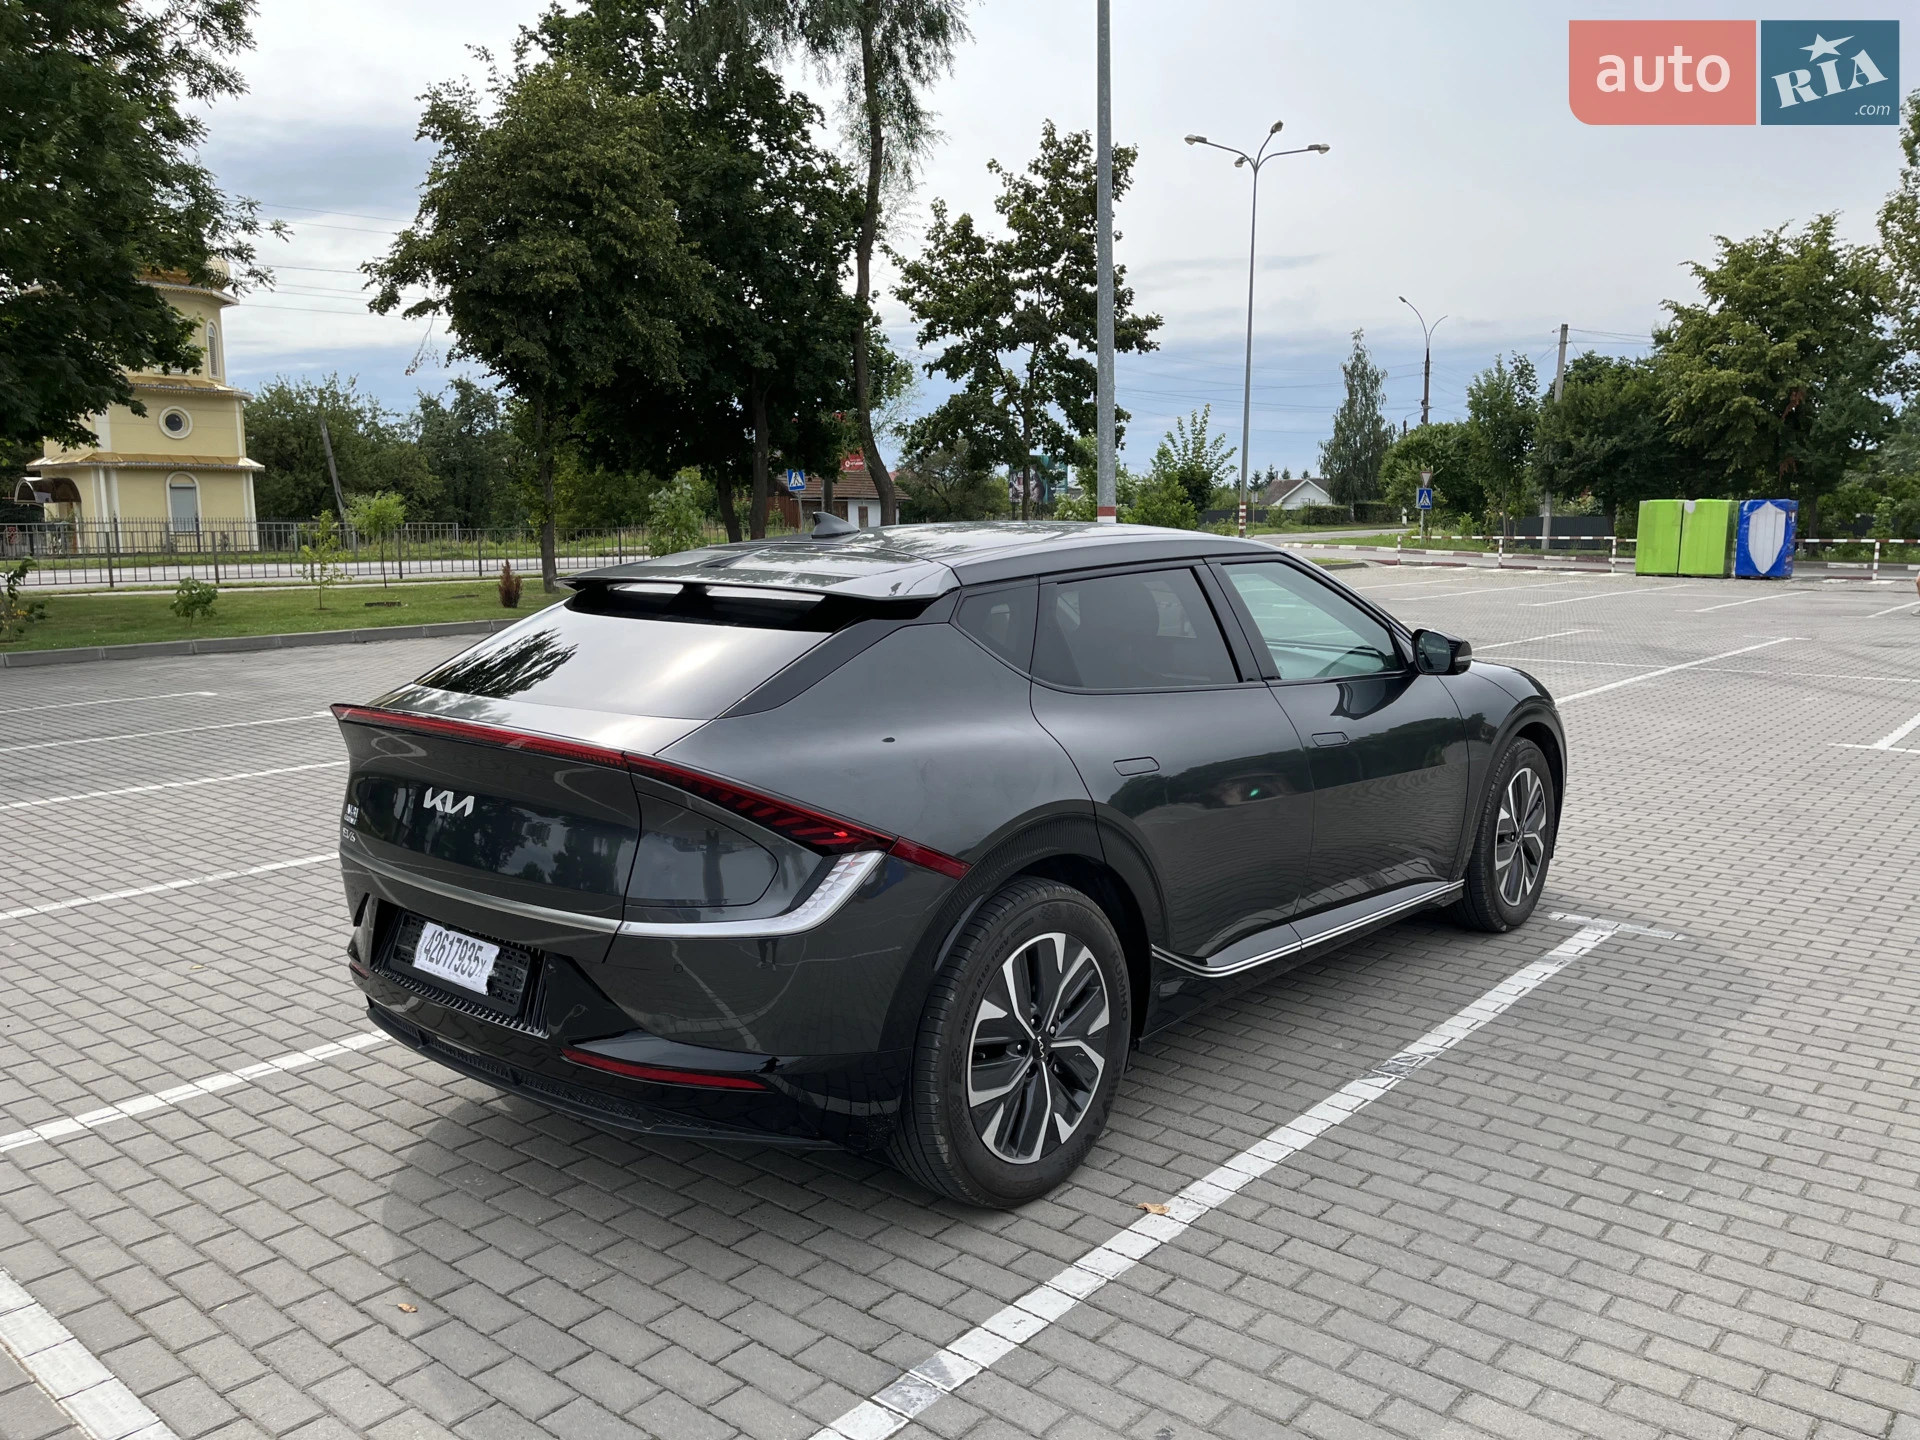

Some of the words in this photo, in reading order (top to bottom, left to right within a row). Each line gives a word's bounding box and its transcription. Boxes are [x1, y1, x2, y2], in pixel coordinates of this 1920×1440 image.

[423, 787, 475, 817] KIA
[342, 827, 356, 843] EV6
[1110, 950, 1128, 1022] KUMHO
